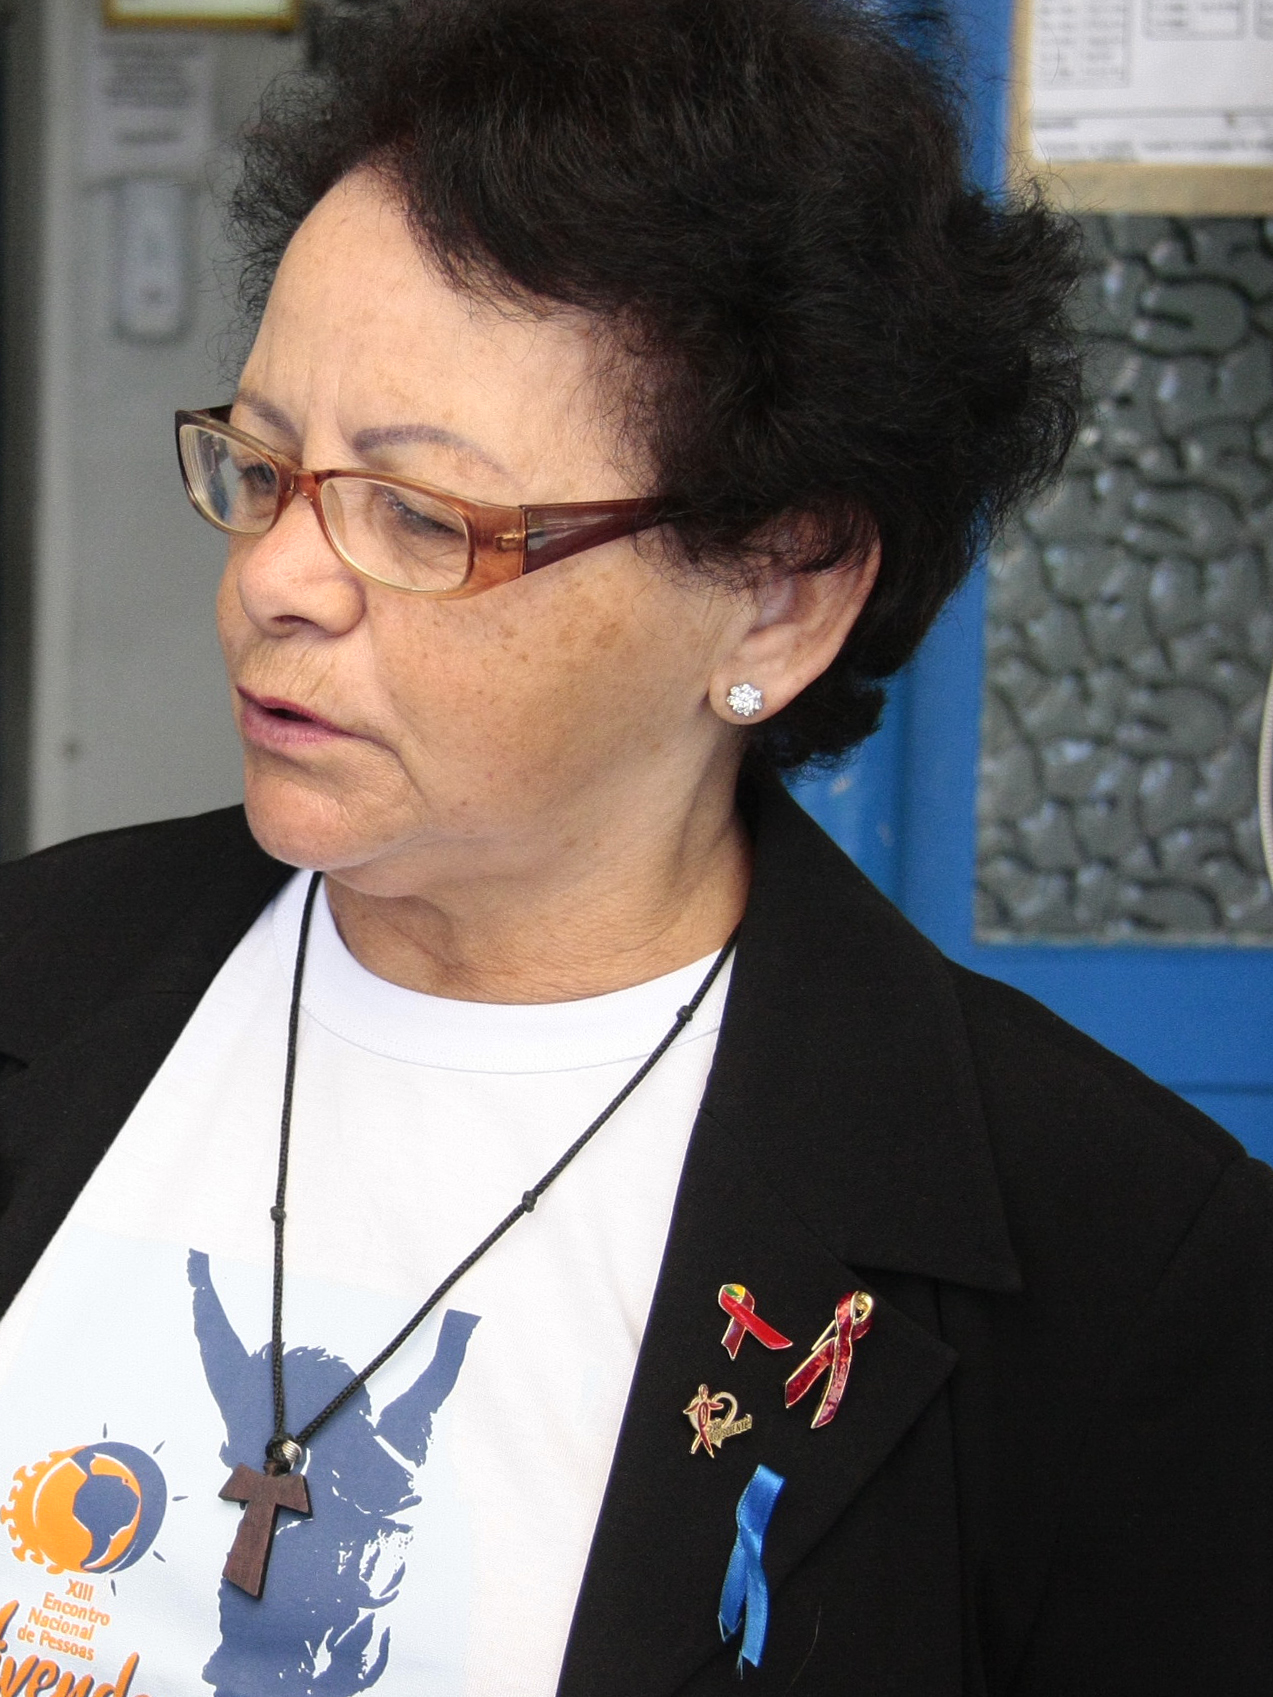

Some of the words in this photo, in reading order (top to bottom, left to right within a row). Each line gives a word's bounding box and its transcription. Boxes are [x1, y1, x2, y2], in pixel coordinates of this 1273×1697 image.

[65, 1578, 94, 1602] XIII
[28, 1606, 95, 1641] Nacional
[42, 1591, 111, 1626] Encontro
[17, 1623, 35, 1643] de
[39, 1629, 95, 1661] Pessoas
